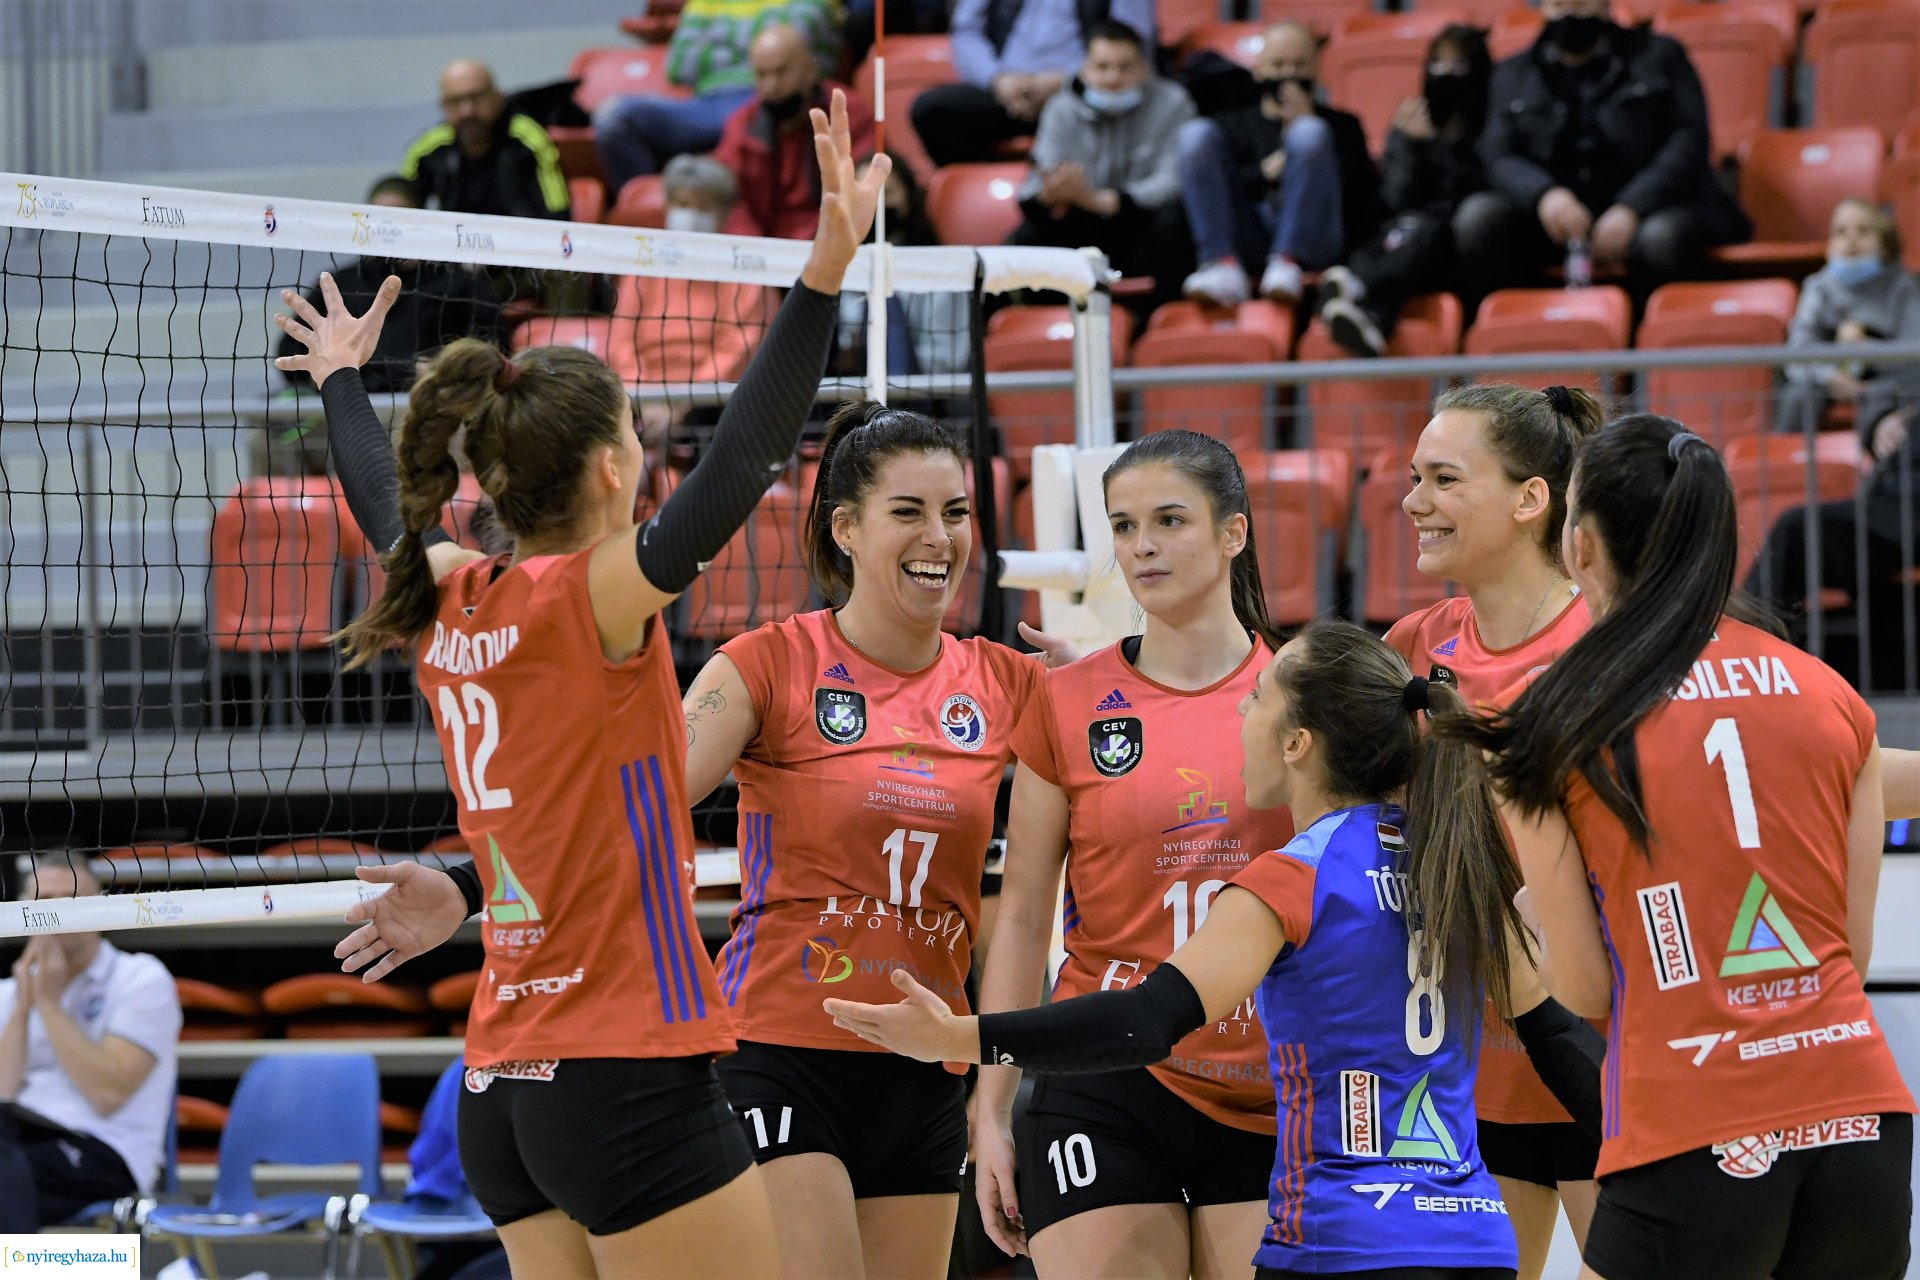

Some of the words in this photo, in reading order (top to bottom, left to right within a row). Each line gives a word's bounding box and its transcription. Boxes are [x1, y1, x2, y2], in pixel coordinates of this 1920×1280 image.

[141, 196, 185, 225] FATUM
[823, 671, 855, 684] adidas
[1667, 655, 1800, 701] SILEVA
[828, 692, 851, 703] CEV
[1096, 701, 1133, 712] adidas
[1102, 721, 1127, 732] CEV
[438, 681, 513, 811] 12
[876, 780, 946, 799] NYÍREGYHÁZI
[1703, 717, 1761, 848] 1
[867, 791, 955, 812] SPORTCENTRUM
[1156, 852, 1250, 867] SPORTCENTRUM
[1163, 837, 1242, 853] NYÍREGYHÁZI
[881, 828, 940, 908] 17
[22, 906, 60, 927] FATUM
[818, 916, 953, 956] PROPER
[1651, 889, 1687, 982] STRABAG
[1405, 930, 1446, 1056] 8
[1727, 978, 1796, 1006] KE-VIZ
[1799, 974, 1821, 995] 21
[1738, 1020, 1872, 1061] BESTRONG
[1352, 1073, 1370, 1154] STRABAG
[1047, 1133, 1098, 1195] 10
